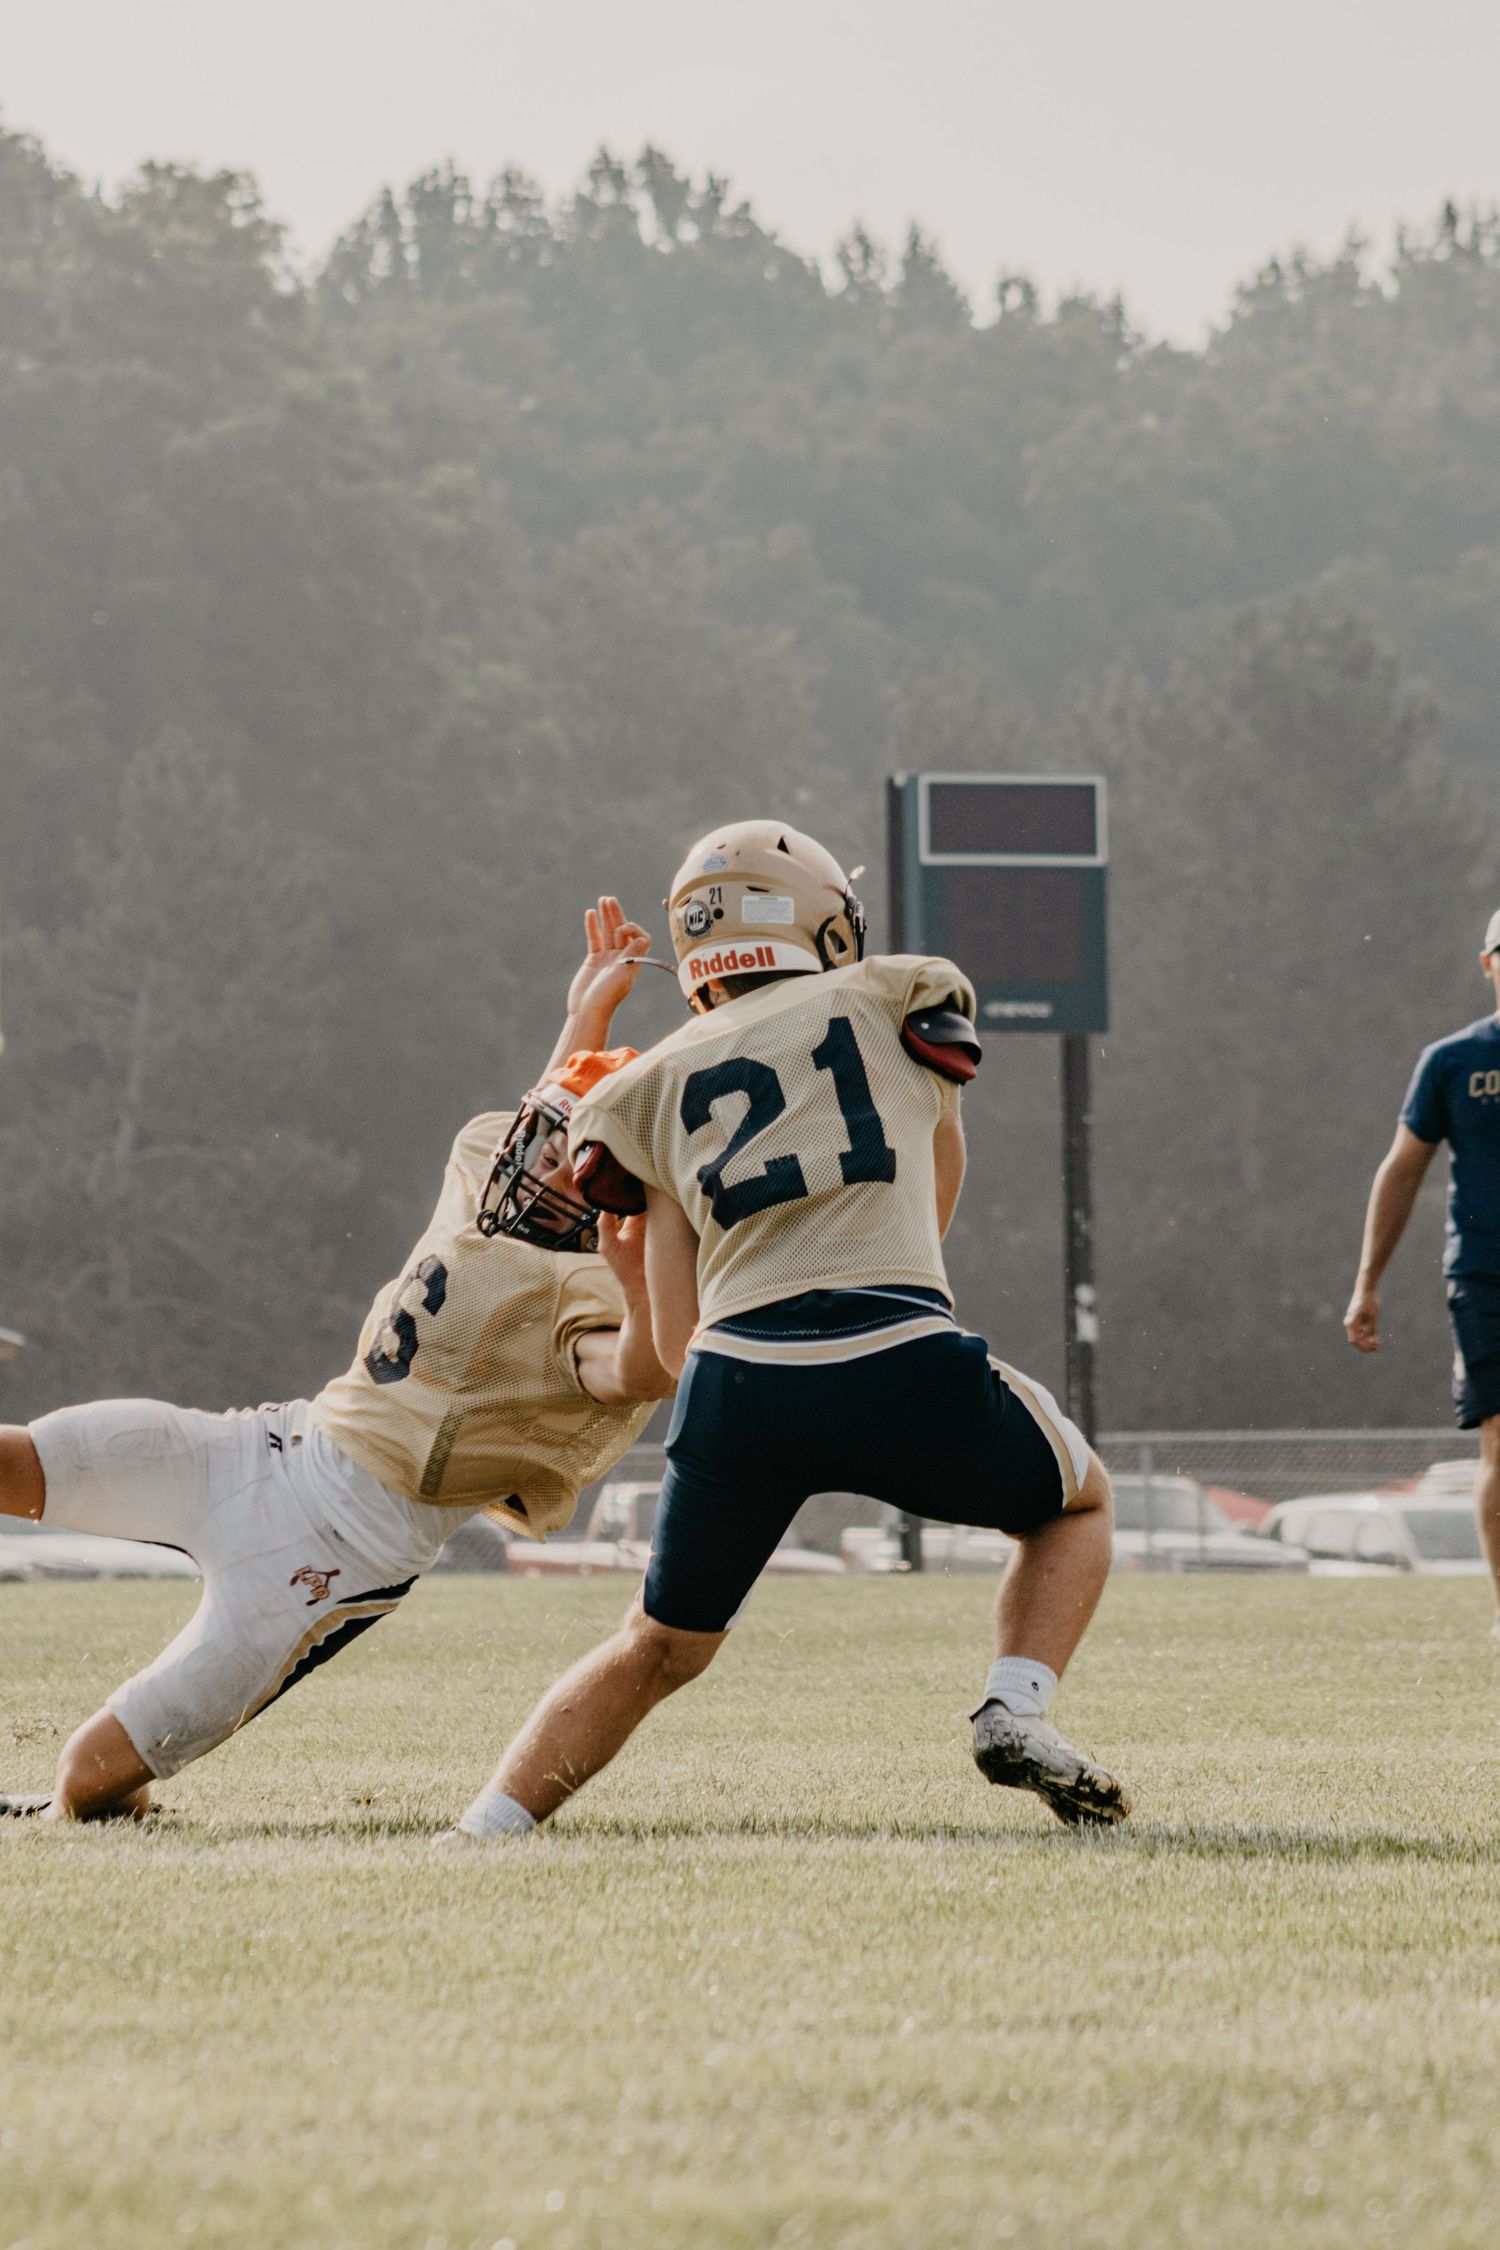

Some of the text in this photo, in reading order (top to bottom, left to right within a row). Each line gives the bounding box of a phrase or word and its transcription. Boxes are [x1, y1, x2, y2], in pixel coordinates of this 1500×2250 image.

[708, 886, 722, 904] 21
[688, 946, 776, 980] Riddell
[680, 1016, 896, 1231] 21
